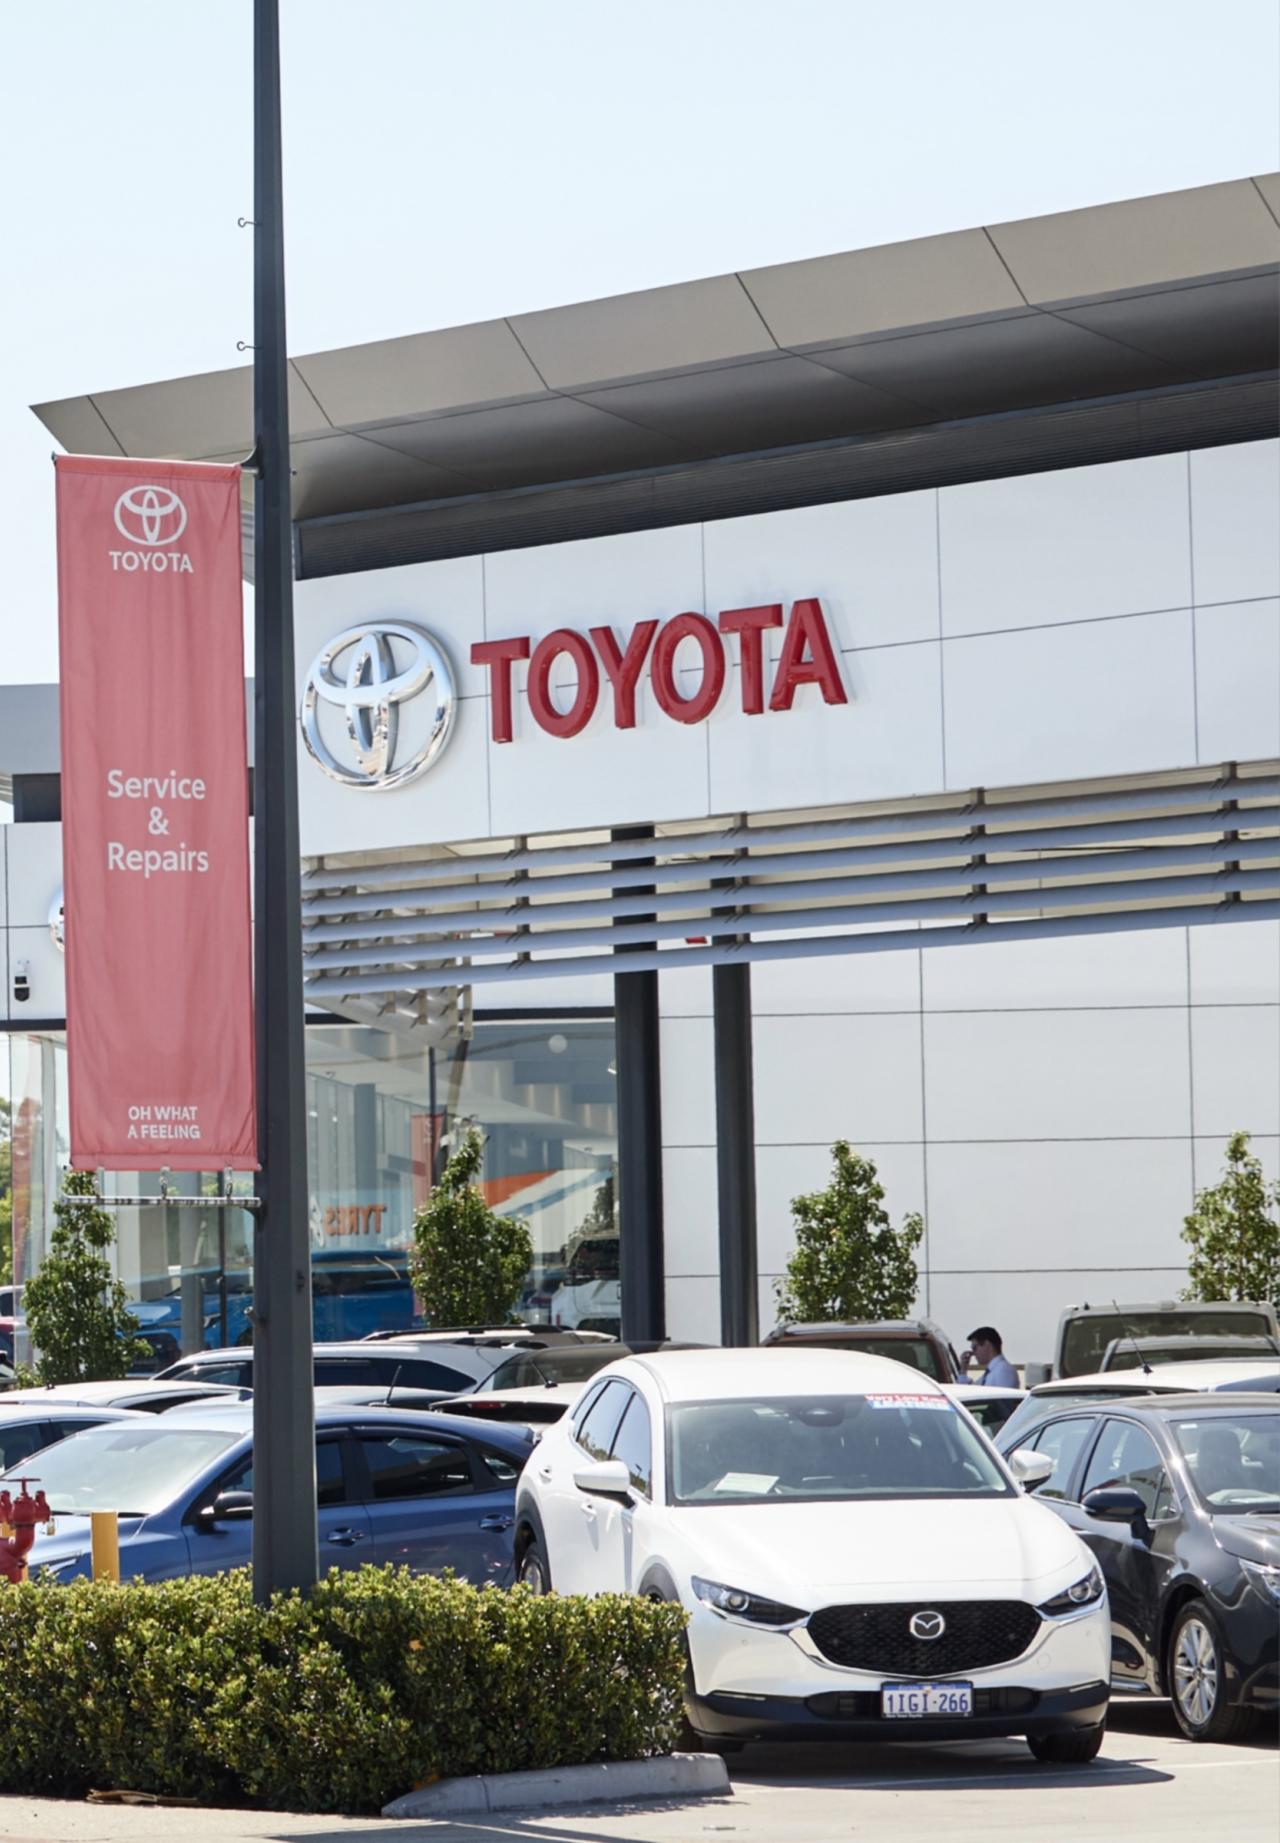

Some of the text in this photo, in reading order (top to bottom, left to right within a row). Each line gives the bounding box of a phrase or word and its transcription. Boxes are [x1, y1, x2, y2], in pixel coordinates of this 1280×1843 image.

[109, 551, 194, 574] TOYOTA
[471, 597, 848, 743] TOYOTA
[107, 770, 207, 800] Service
[148, 807, 169, 835] &
[107, 842, 209, 877] Repairs
[128, 1105, 198, 1121] OH WHAT
[127, 1124, 201, 1140] A FEELING
